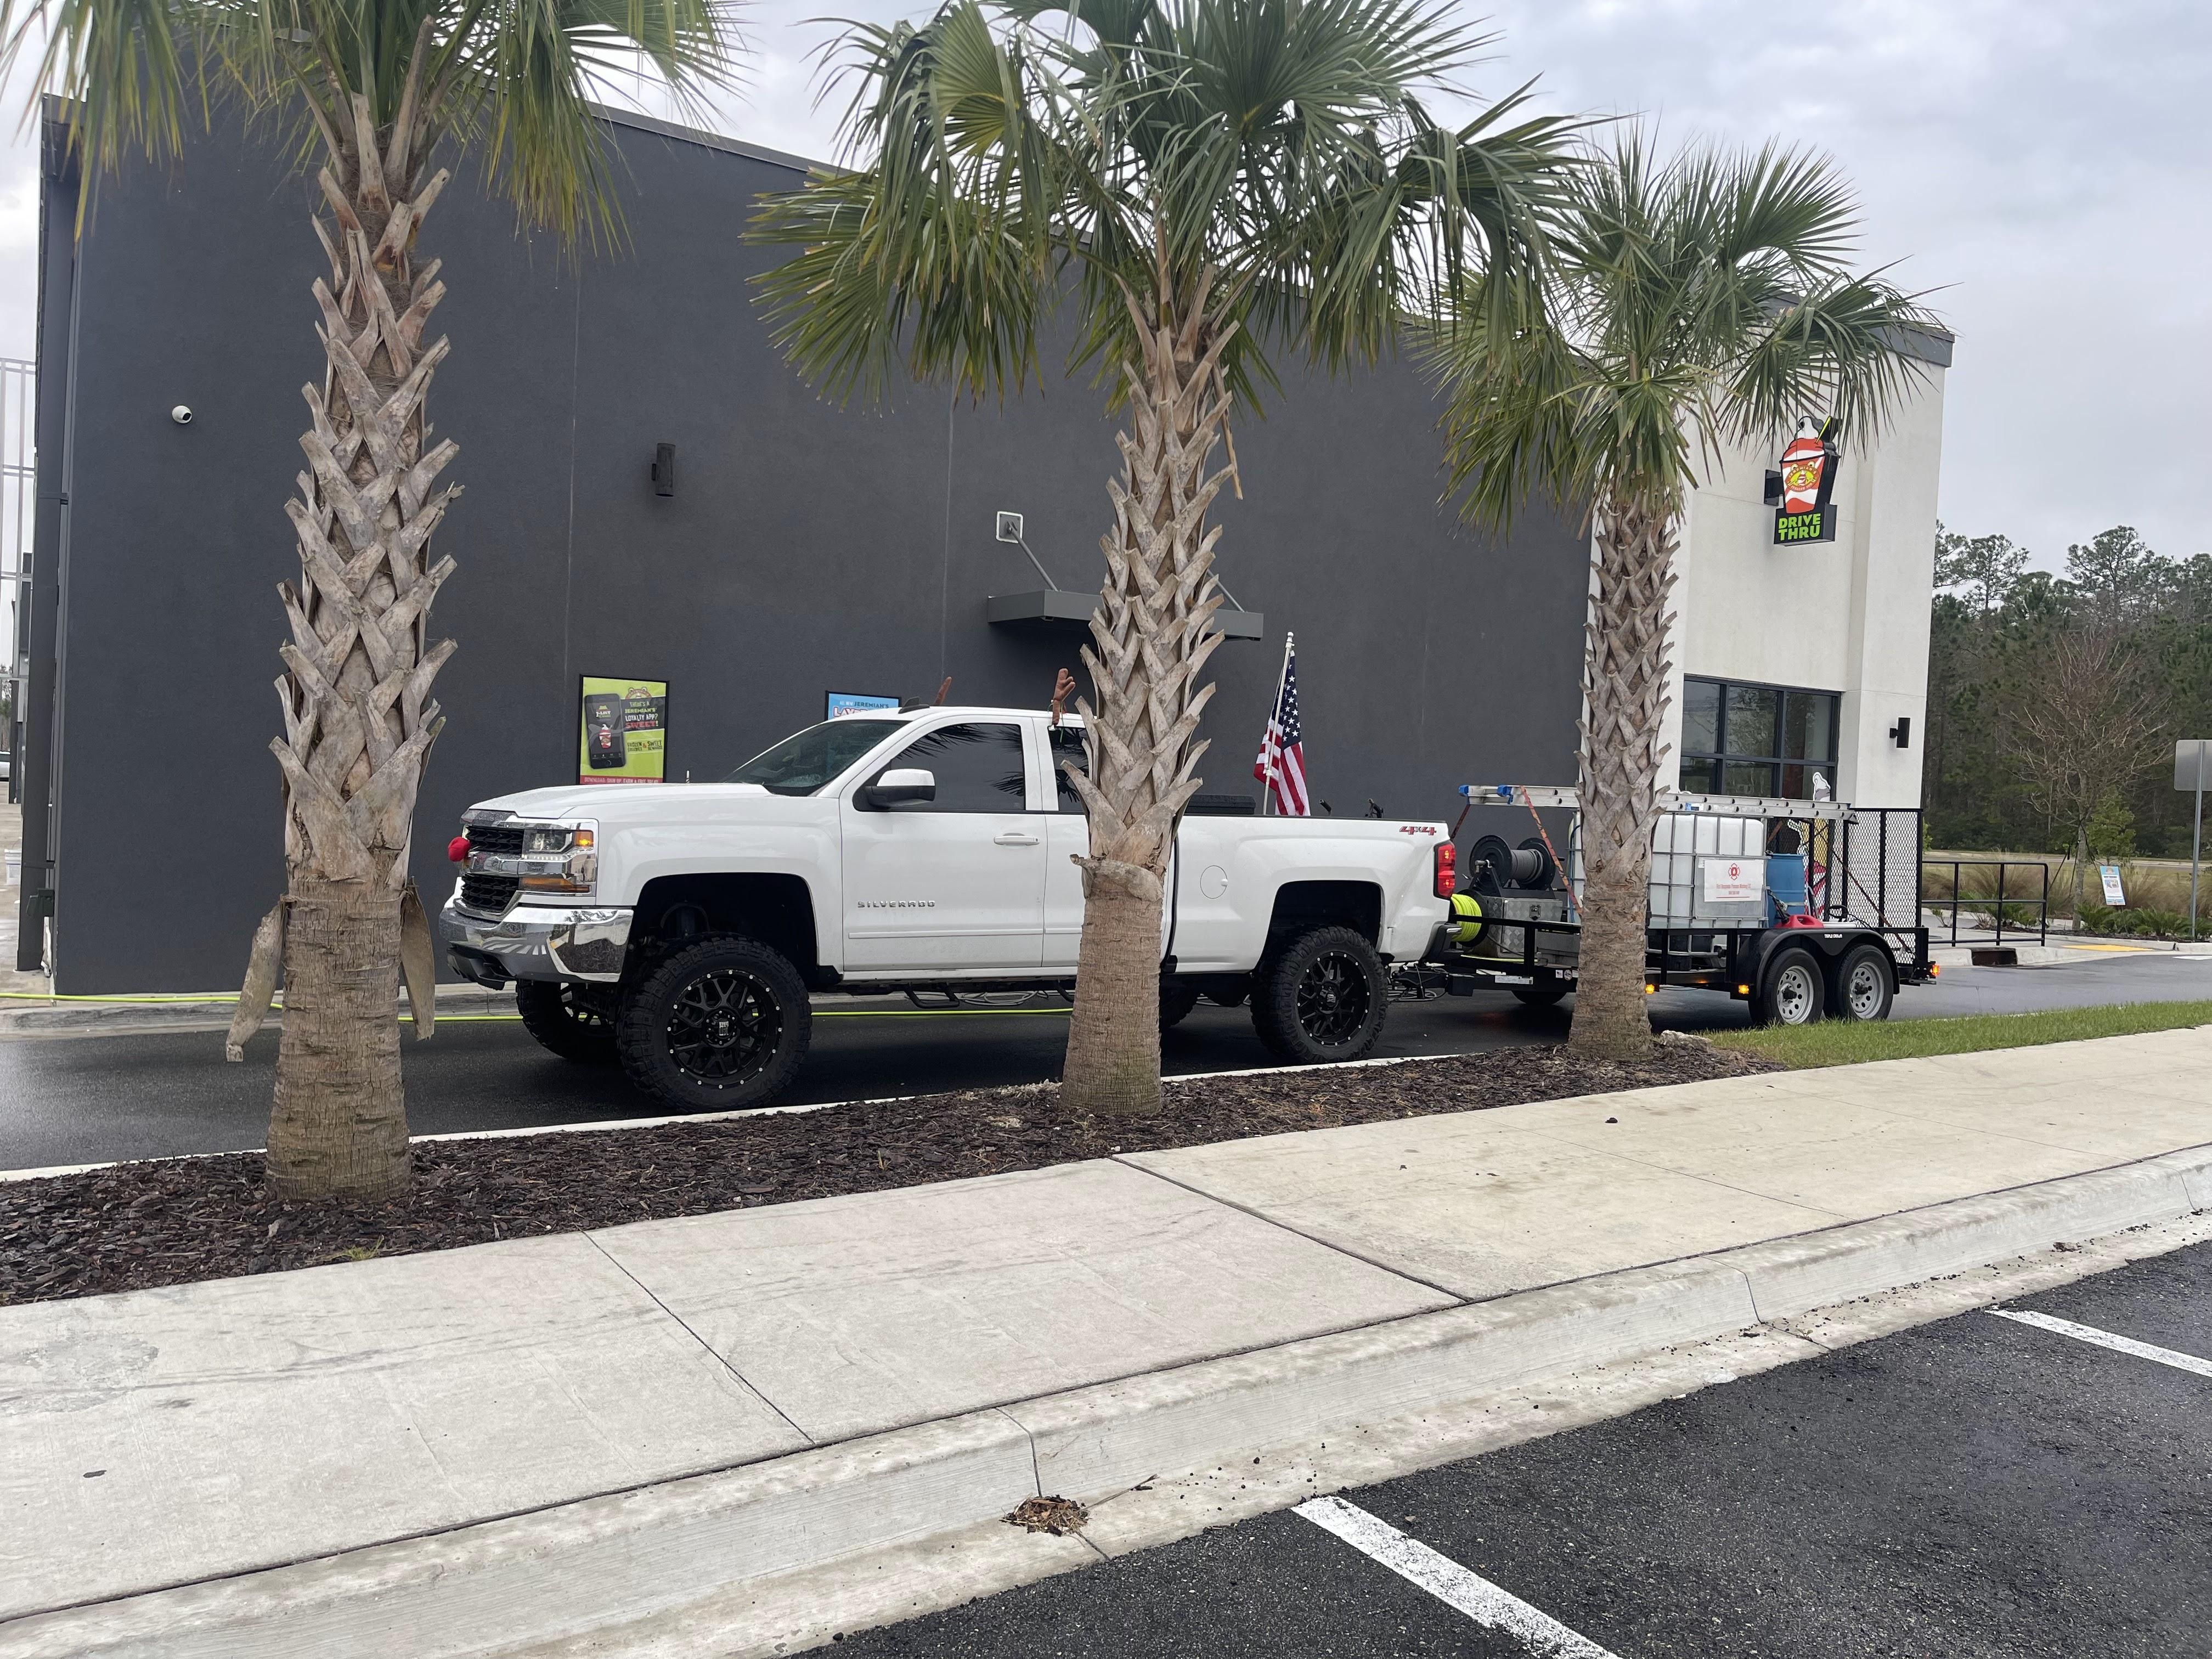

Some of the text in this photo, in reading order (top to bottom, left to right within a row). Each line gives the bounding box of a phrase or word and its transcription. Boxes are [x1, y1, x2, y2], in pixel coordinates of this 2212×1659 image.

[1779, 513, 1821, 529] DRIVE
[1779, 524, 1821, 541] THRU
[625, 720, 659, 729] SWEET!
